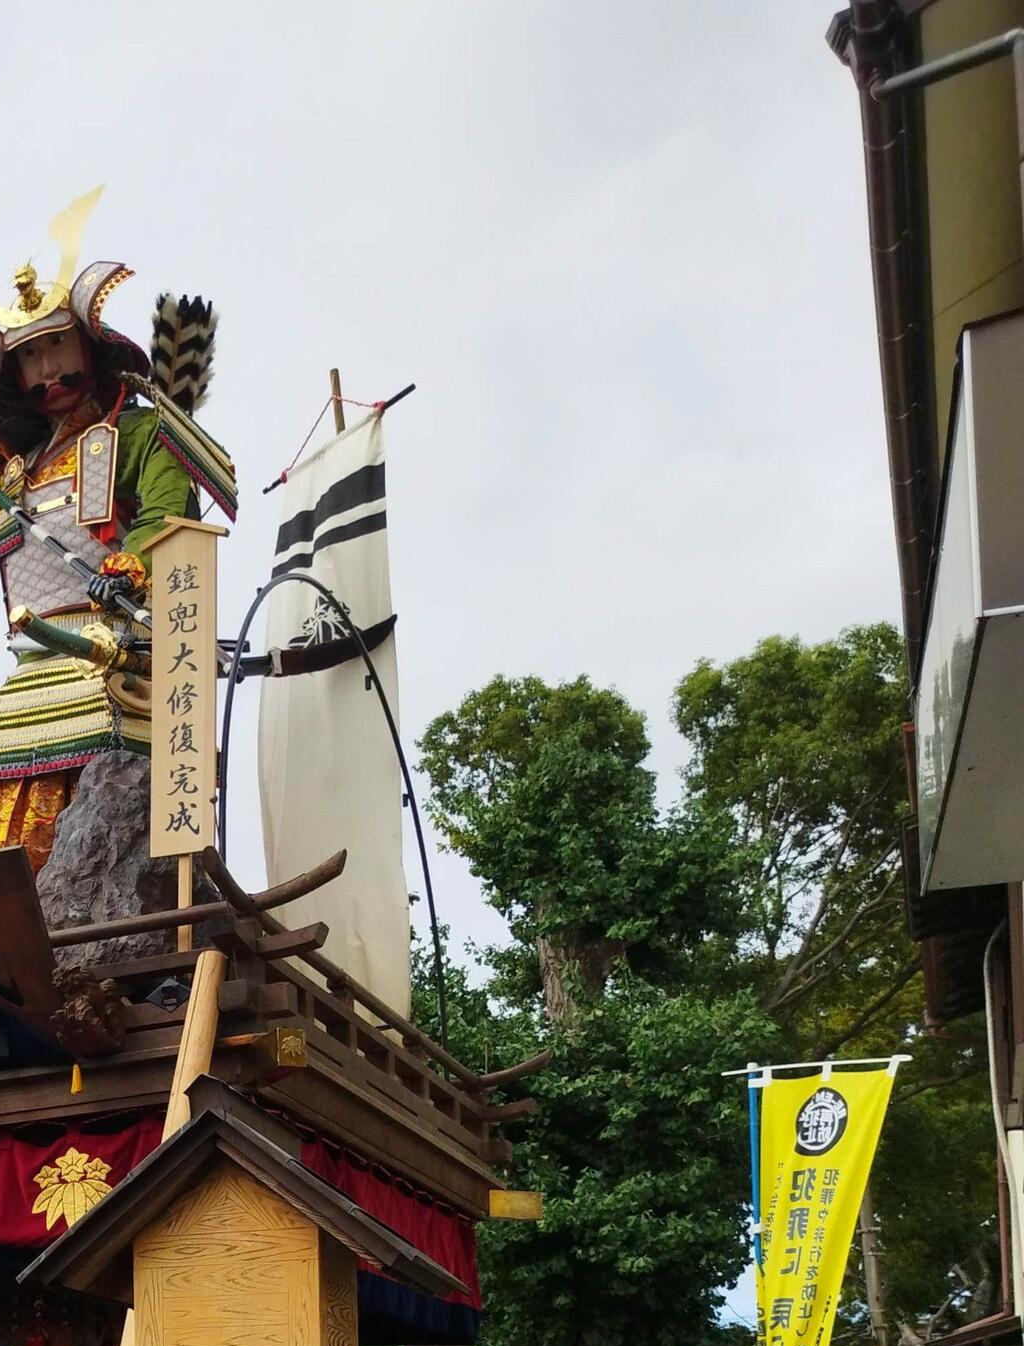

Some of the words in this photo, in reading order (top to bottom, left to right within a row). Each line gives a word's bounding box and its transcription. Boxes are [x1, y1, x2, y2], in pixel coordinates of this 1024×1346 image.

[164, 564, 202, 837] 鎧兜大修復完成
